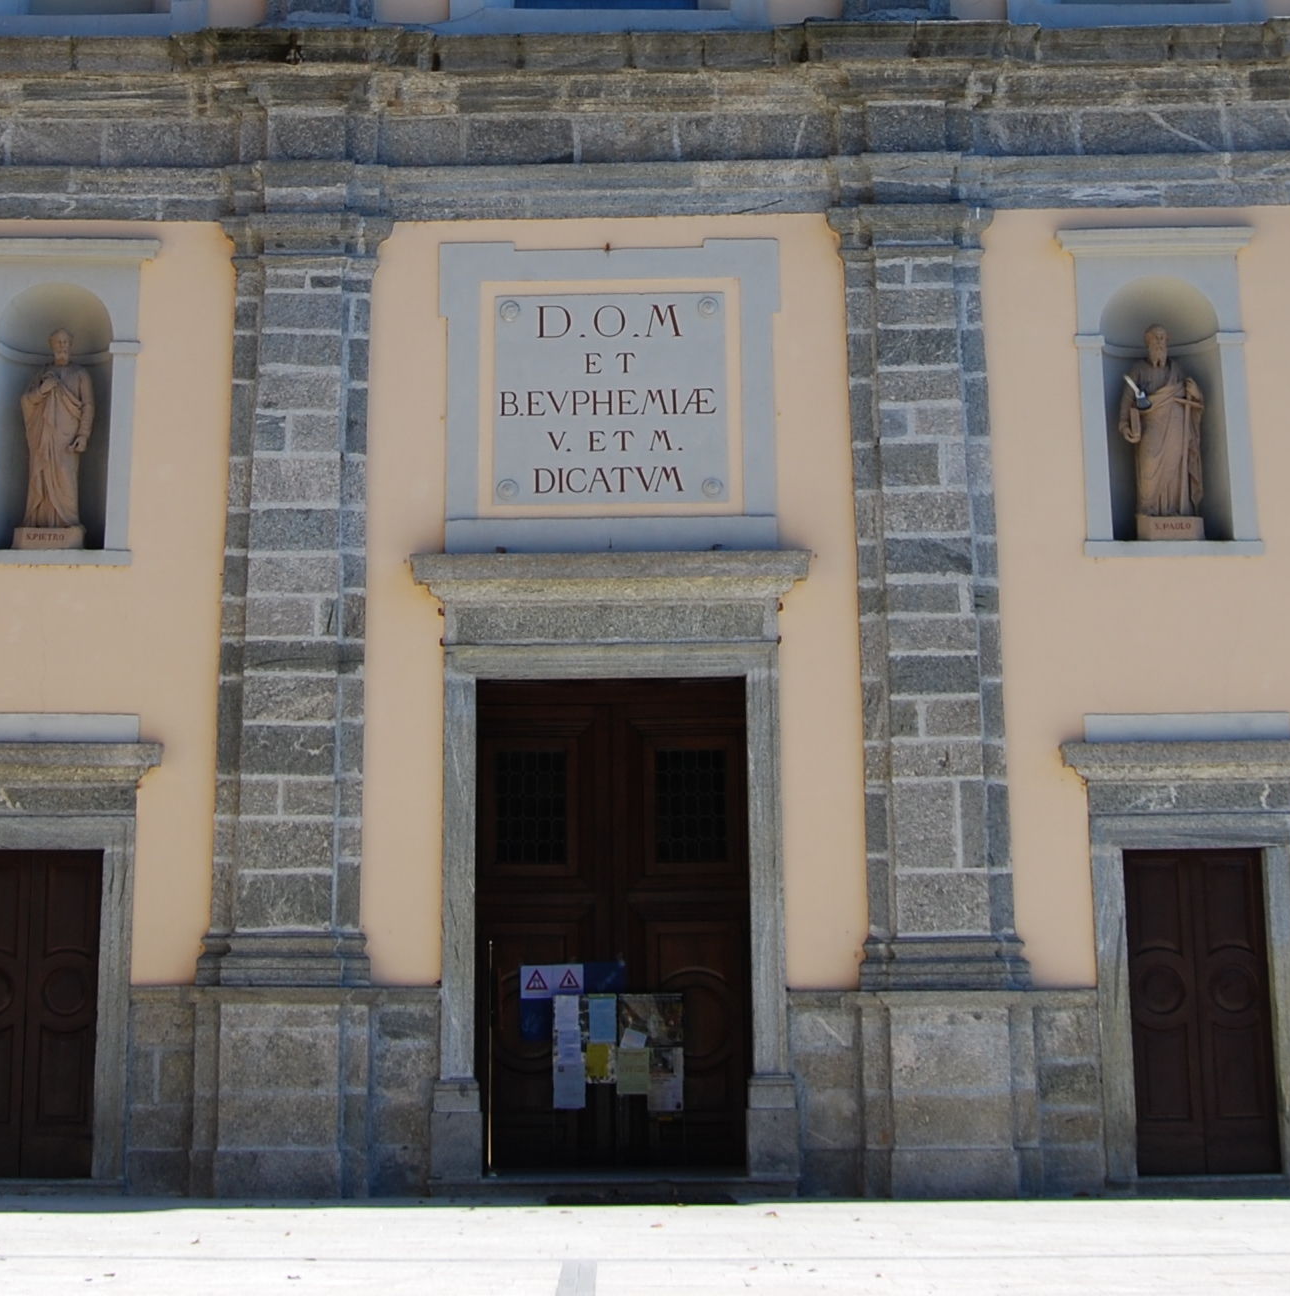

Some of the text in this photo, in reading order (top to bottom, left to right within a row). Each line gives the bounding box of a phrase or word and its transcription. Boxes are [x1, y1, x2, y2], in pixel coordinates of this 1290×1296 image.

[585, 352, 636, 375] ET
[547, 430, 683, 452] V. ET M.
[534, 466, 684, 494] DICATVM
